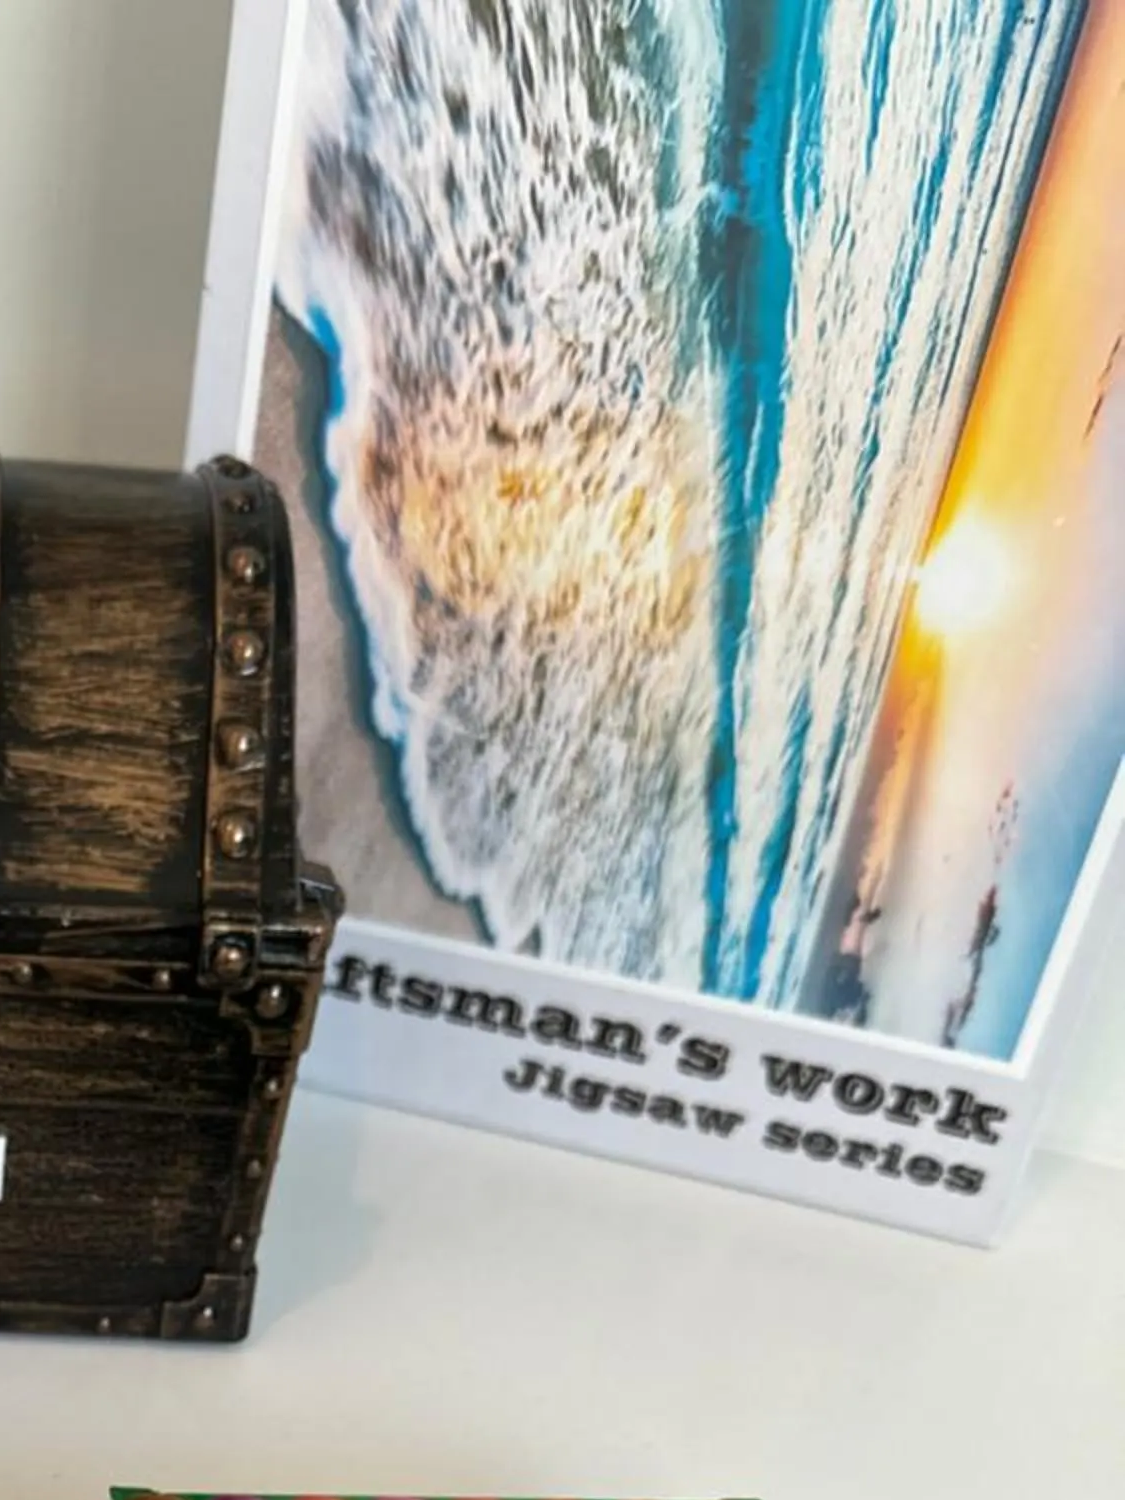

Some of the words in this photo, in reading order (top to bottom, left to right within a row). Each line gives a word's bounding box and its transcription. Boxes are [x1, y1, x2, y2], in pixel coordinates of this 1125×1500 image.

[327, 953, 732, 1080] ftsman's
[760, 1051, 1009, 1145] work
[504, 1056, 746, 1140] Jigsaw
[762, 1116, 987, 1196] series
